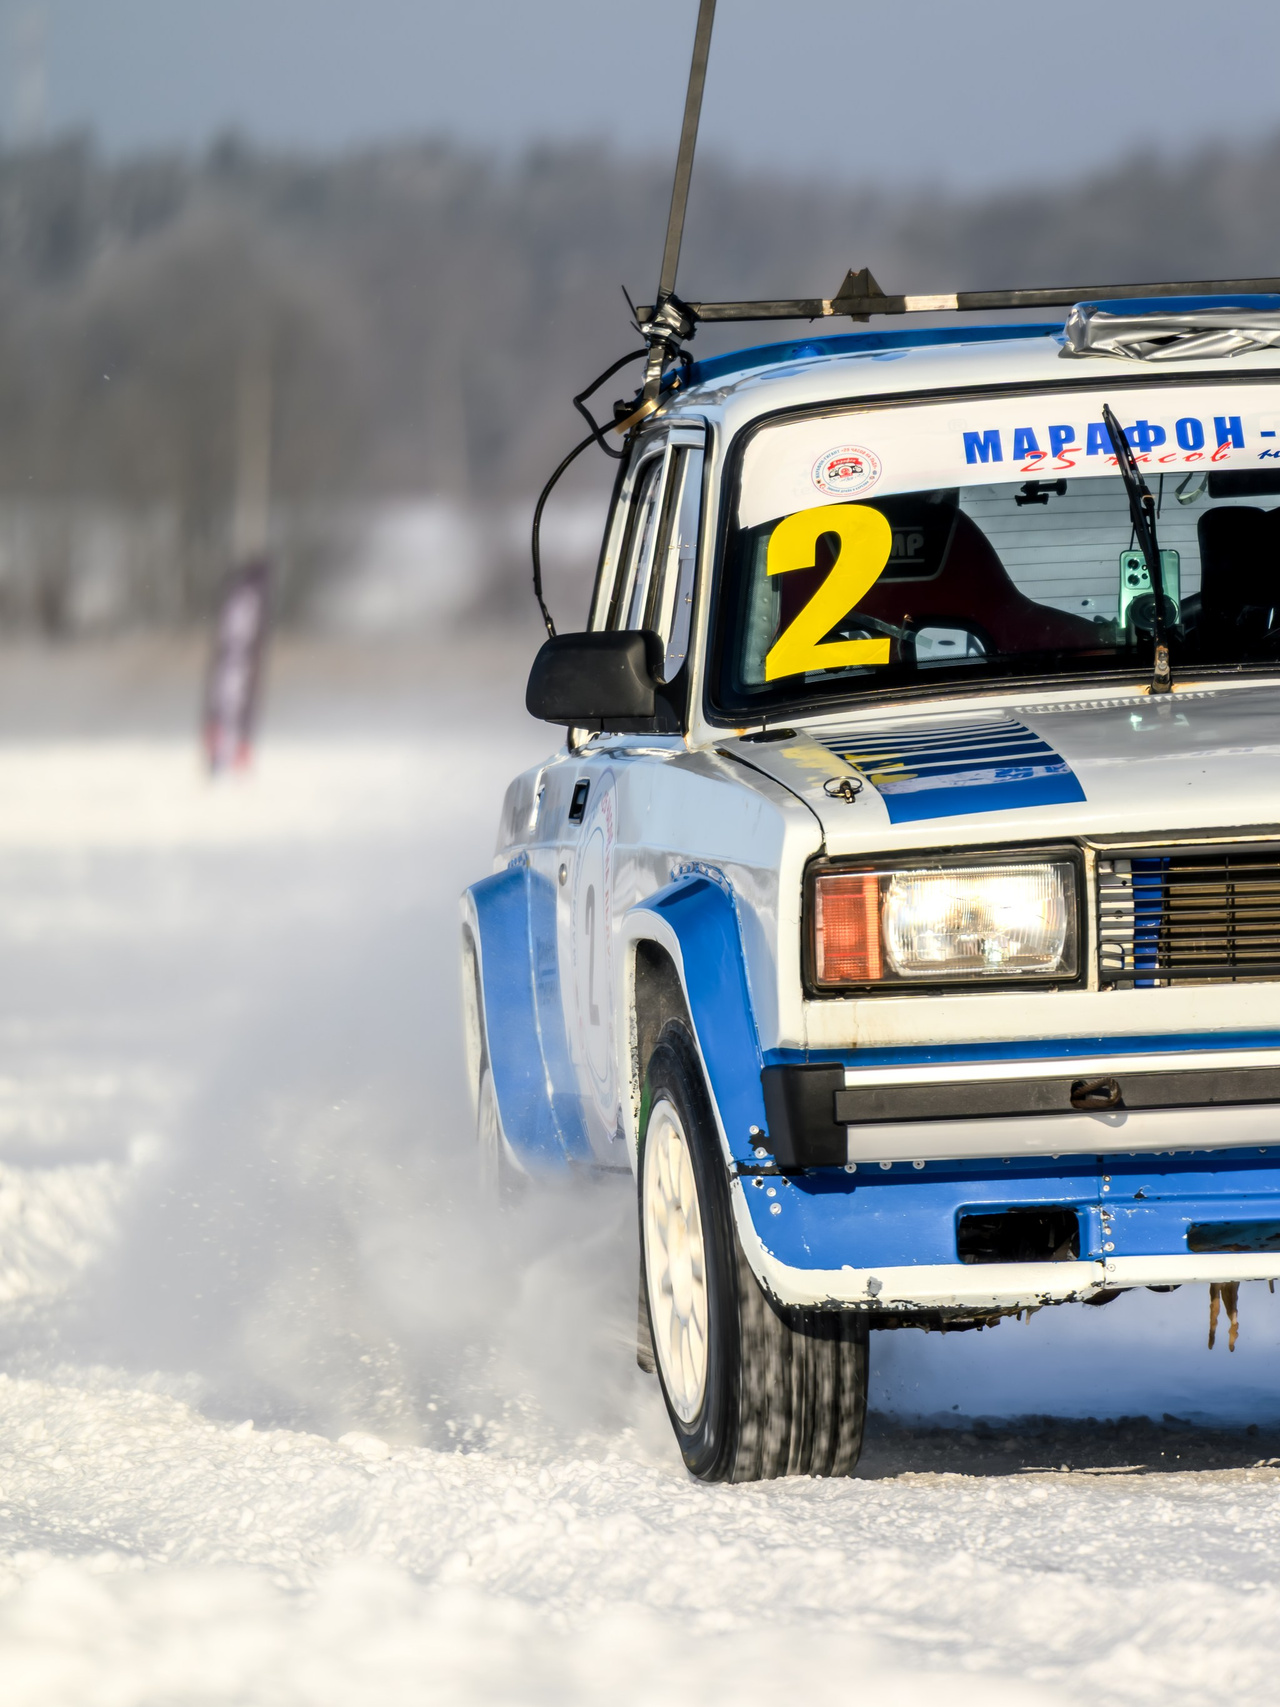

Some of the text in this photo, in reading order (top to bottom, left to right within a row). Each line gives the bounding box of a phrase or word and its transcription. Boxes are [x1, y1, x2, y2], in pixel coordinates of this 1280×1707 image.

[1020, 448, 1082, 472] 25
[891, 532, 925, 557] MP
[765, 504, 892, 682] 2
[585, 884, 600, 1026] 2
